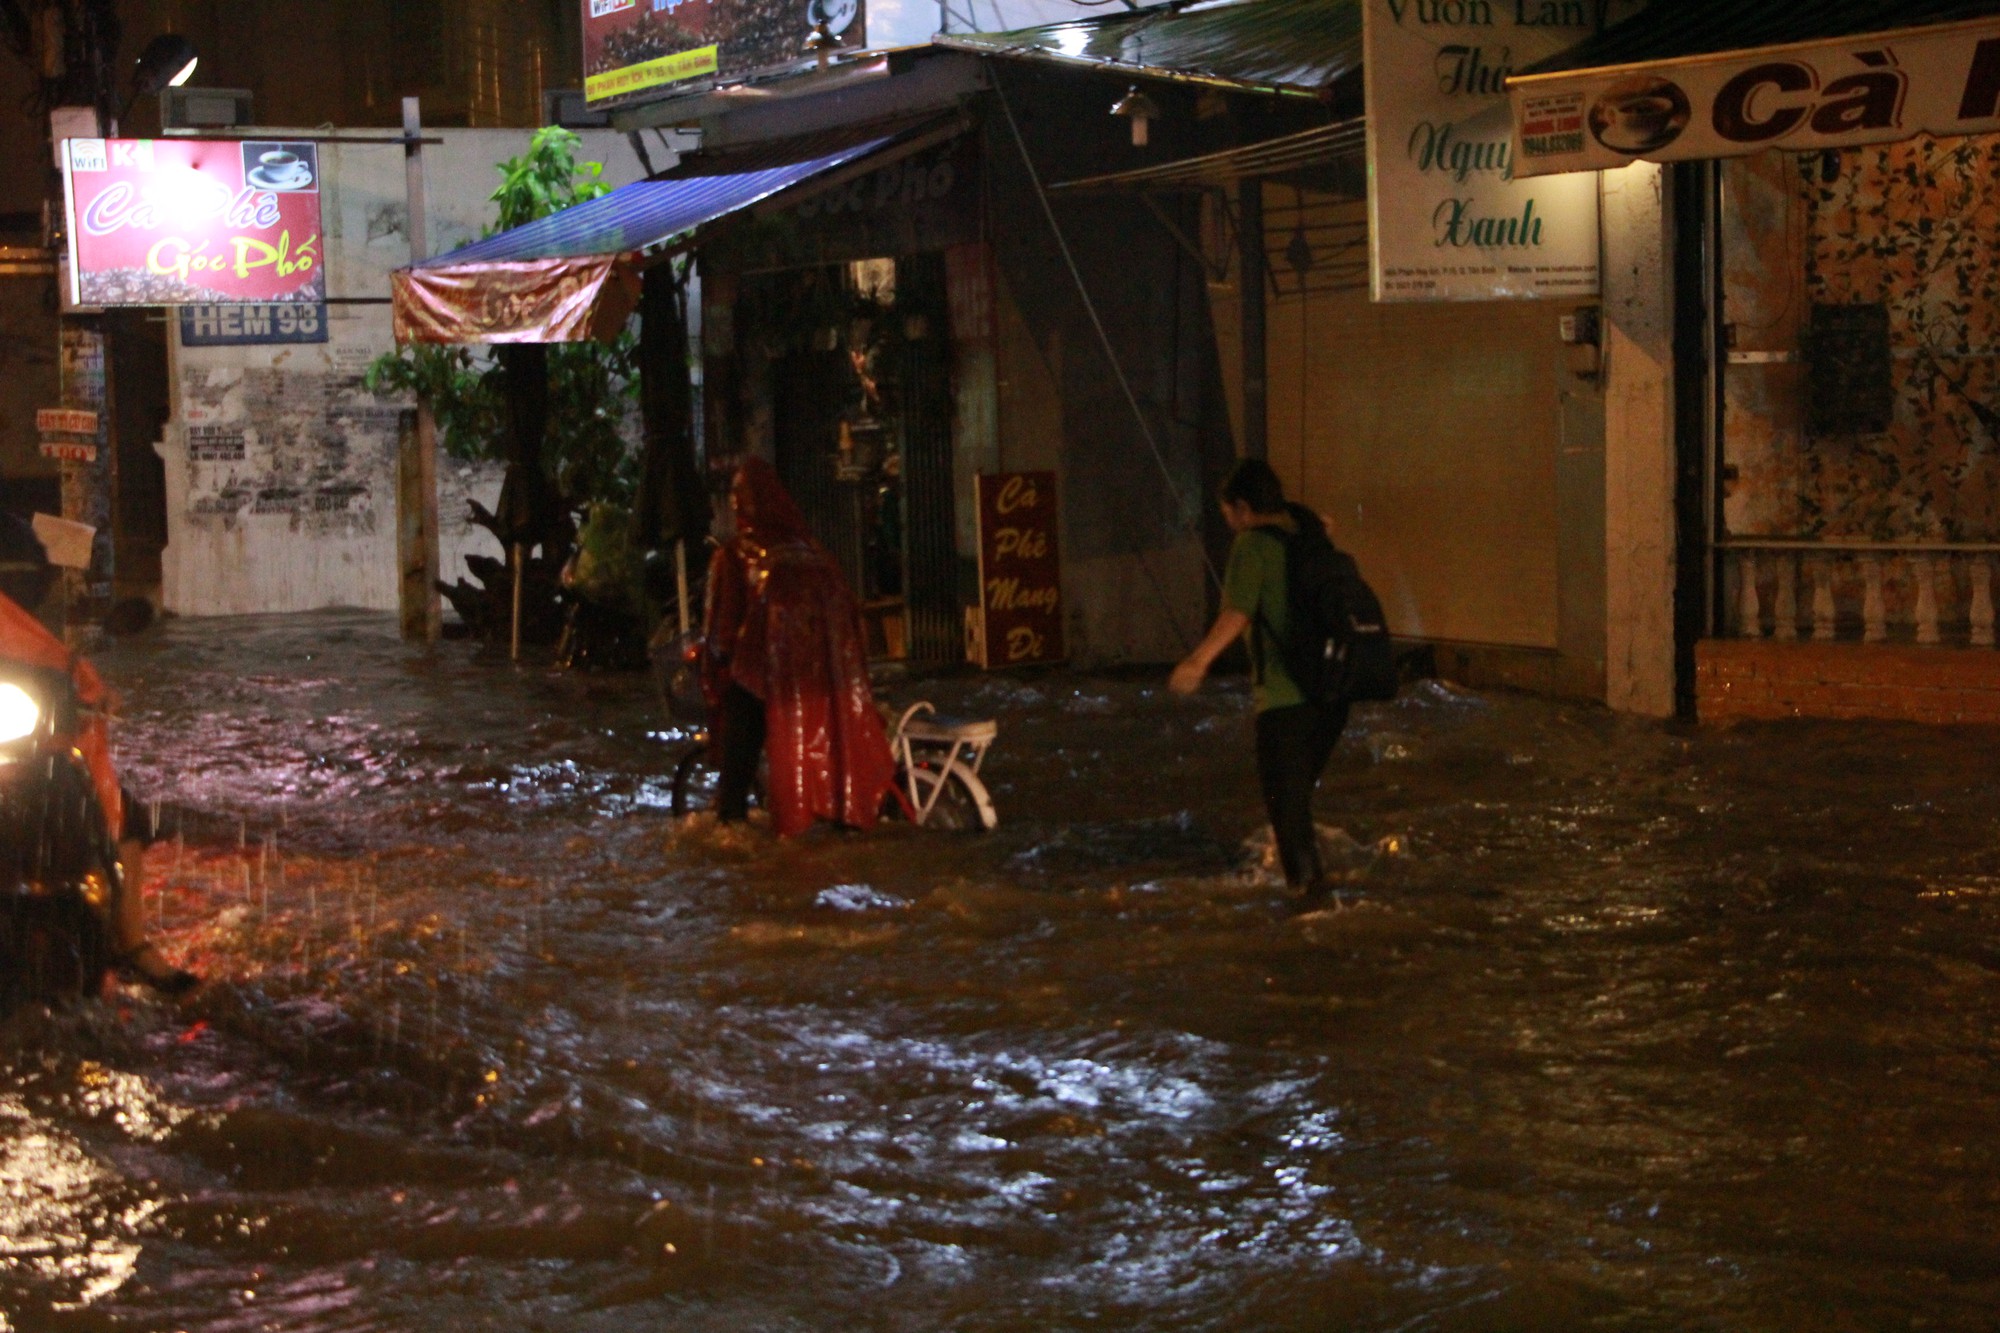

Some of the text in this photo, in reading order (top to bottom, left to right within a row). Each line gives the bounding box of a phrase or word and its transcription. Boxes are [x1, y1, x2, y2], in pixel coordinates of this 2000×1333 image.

[1434, 44, 1513, 95] Thả
[1712, 46, 1909, 143] Cà
[1407, 120, 1514, 182] Nguy
[1431, 198, 1545, 248] Xanh
[147, 229, 318, 280] Góc Phố
[277, 304, 319, 334] 98
[996, 474, 1038, 515] Cà
[993, 526, 1048, 562] Phê
[986, 576, 1059, 615] Mang
